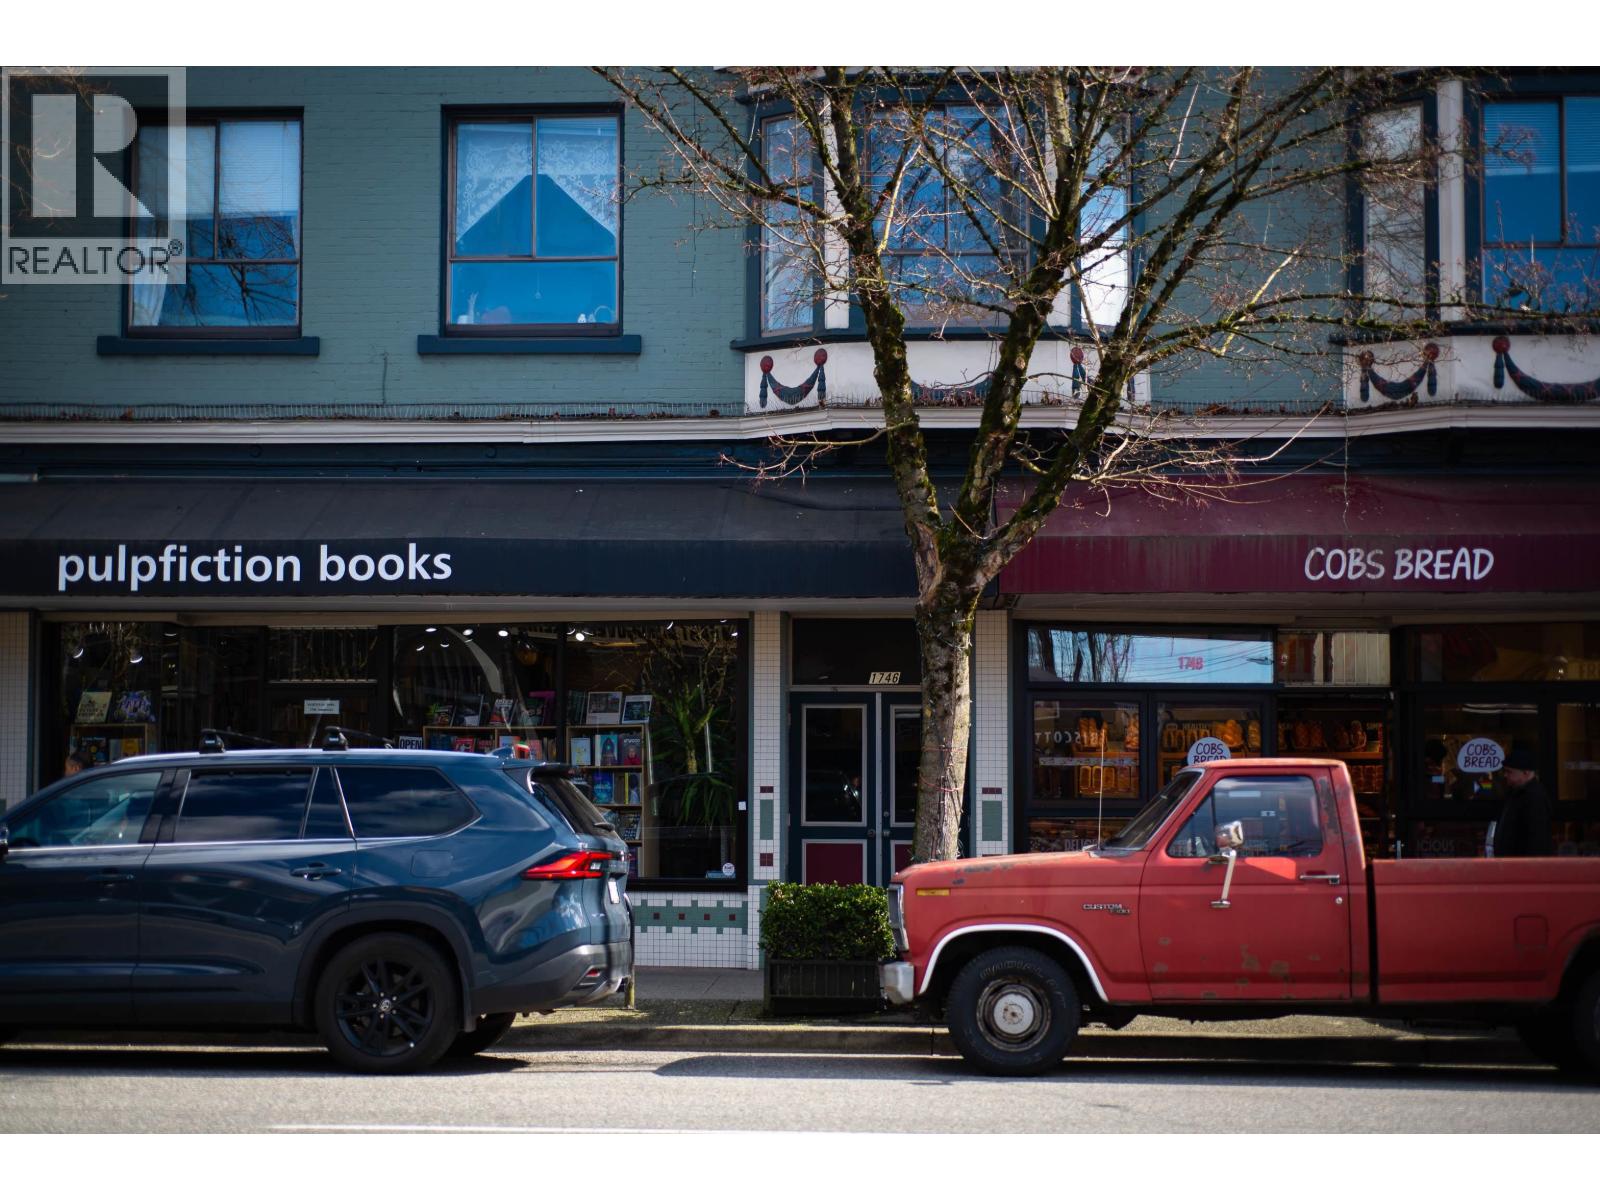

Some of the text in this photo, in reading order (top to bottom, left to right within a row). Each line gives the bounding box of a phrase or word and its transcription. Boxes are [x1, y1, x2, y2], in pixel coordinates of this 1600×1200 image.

[58, 543, 453, 592] pulpfiction books
[1304, 547, 1495, 581] COBS BREAD
[872, 672, 900, 684] 1746
[399, 738, 423, 750] OPEN
[1195, 742, 1224, 755] COBS
[1466, 743, 1497, 756] COBS
[1463, 756, 1501, 768] BREAD
